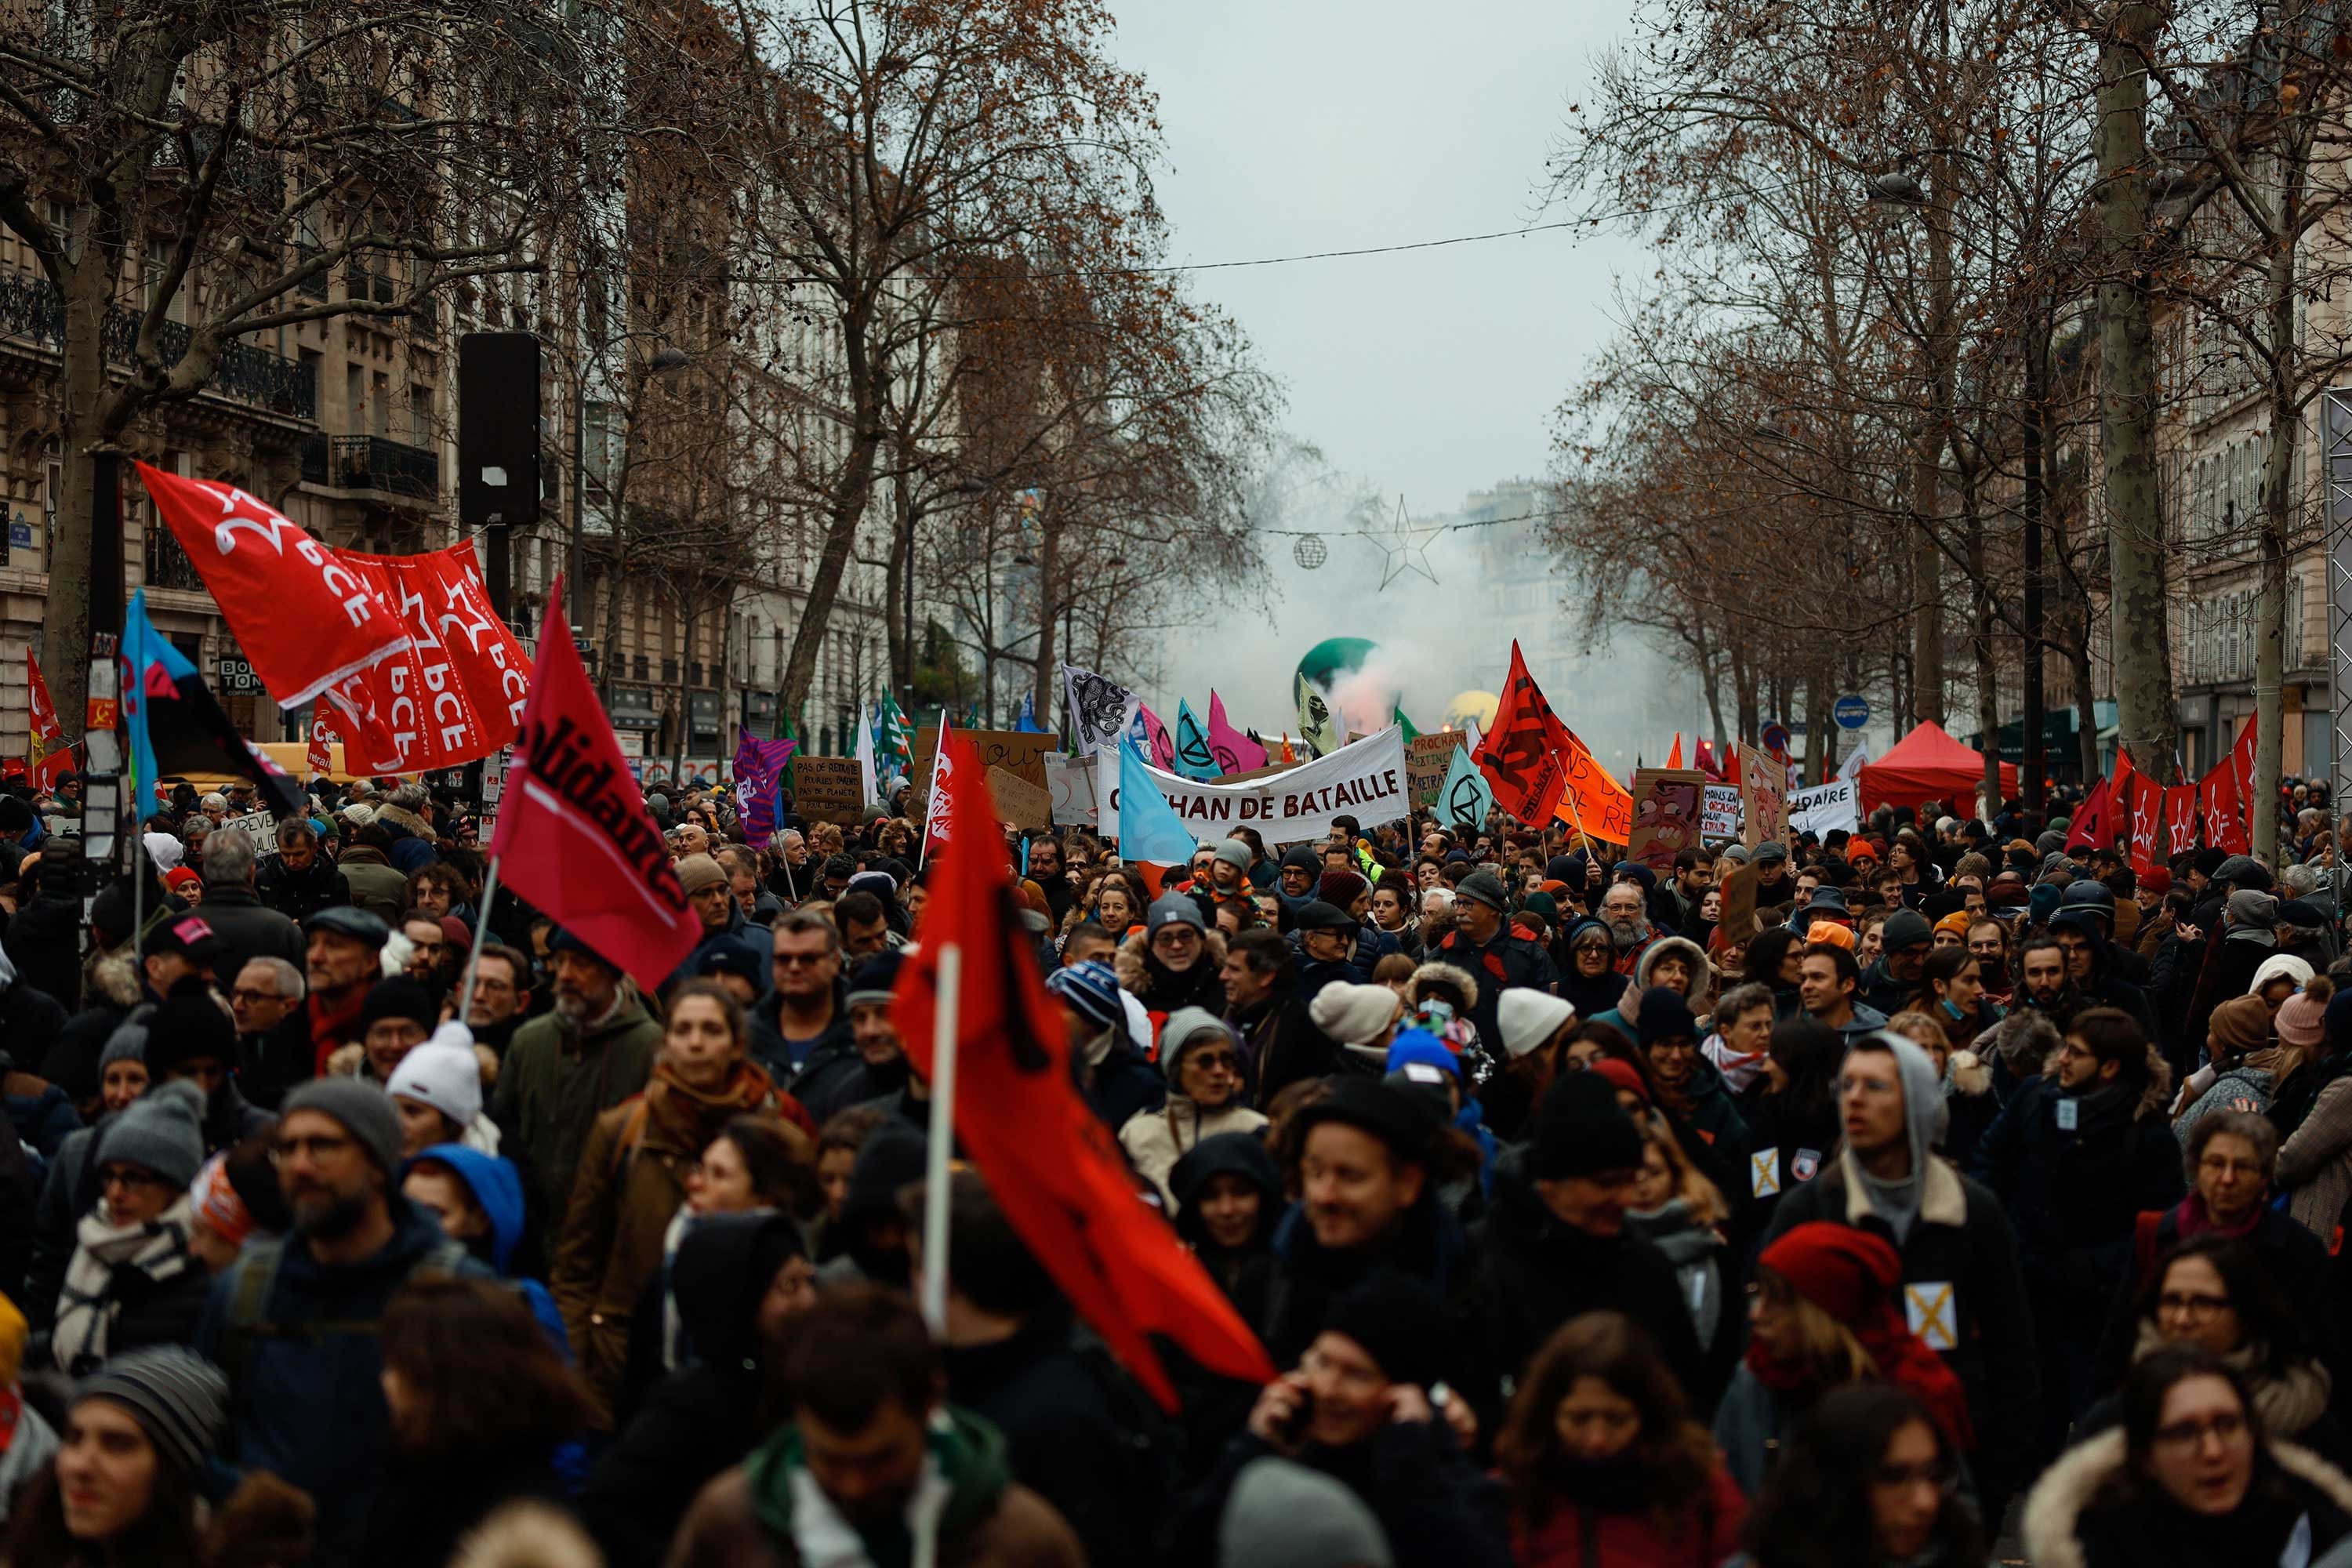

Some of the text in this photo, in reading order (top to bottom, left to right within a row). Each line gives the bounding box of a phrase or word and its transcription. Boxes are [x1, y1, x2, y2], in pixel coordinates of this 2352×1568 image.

[224, 676, 262, 687] TON
[797, 762, 858, 775] PAS DE RETRAITE
[804, 775, 821, 784] POUR
[799, 787, 811, 797] PAS
[1239, 796, 1275, 820] DE
[1283, 768, 1399, 818] BATAILLE
[1601, 778, 1624, 808] DE
[1704, 789, 1738, 803] MOINS EN
[806, 801, 822, 810] POUR
[825, 801, 835, 810] LES
